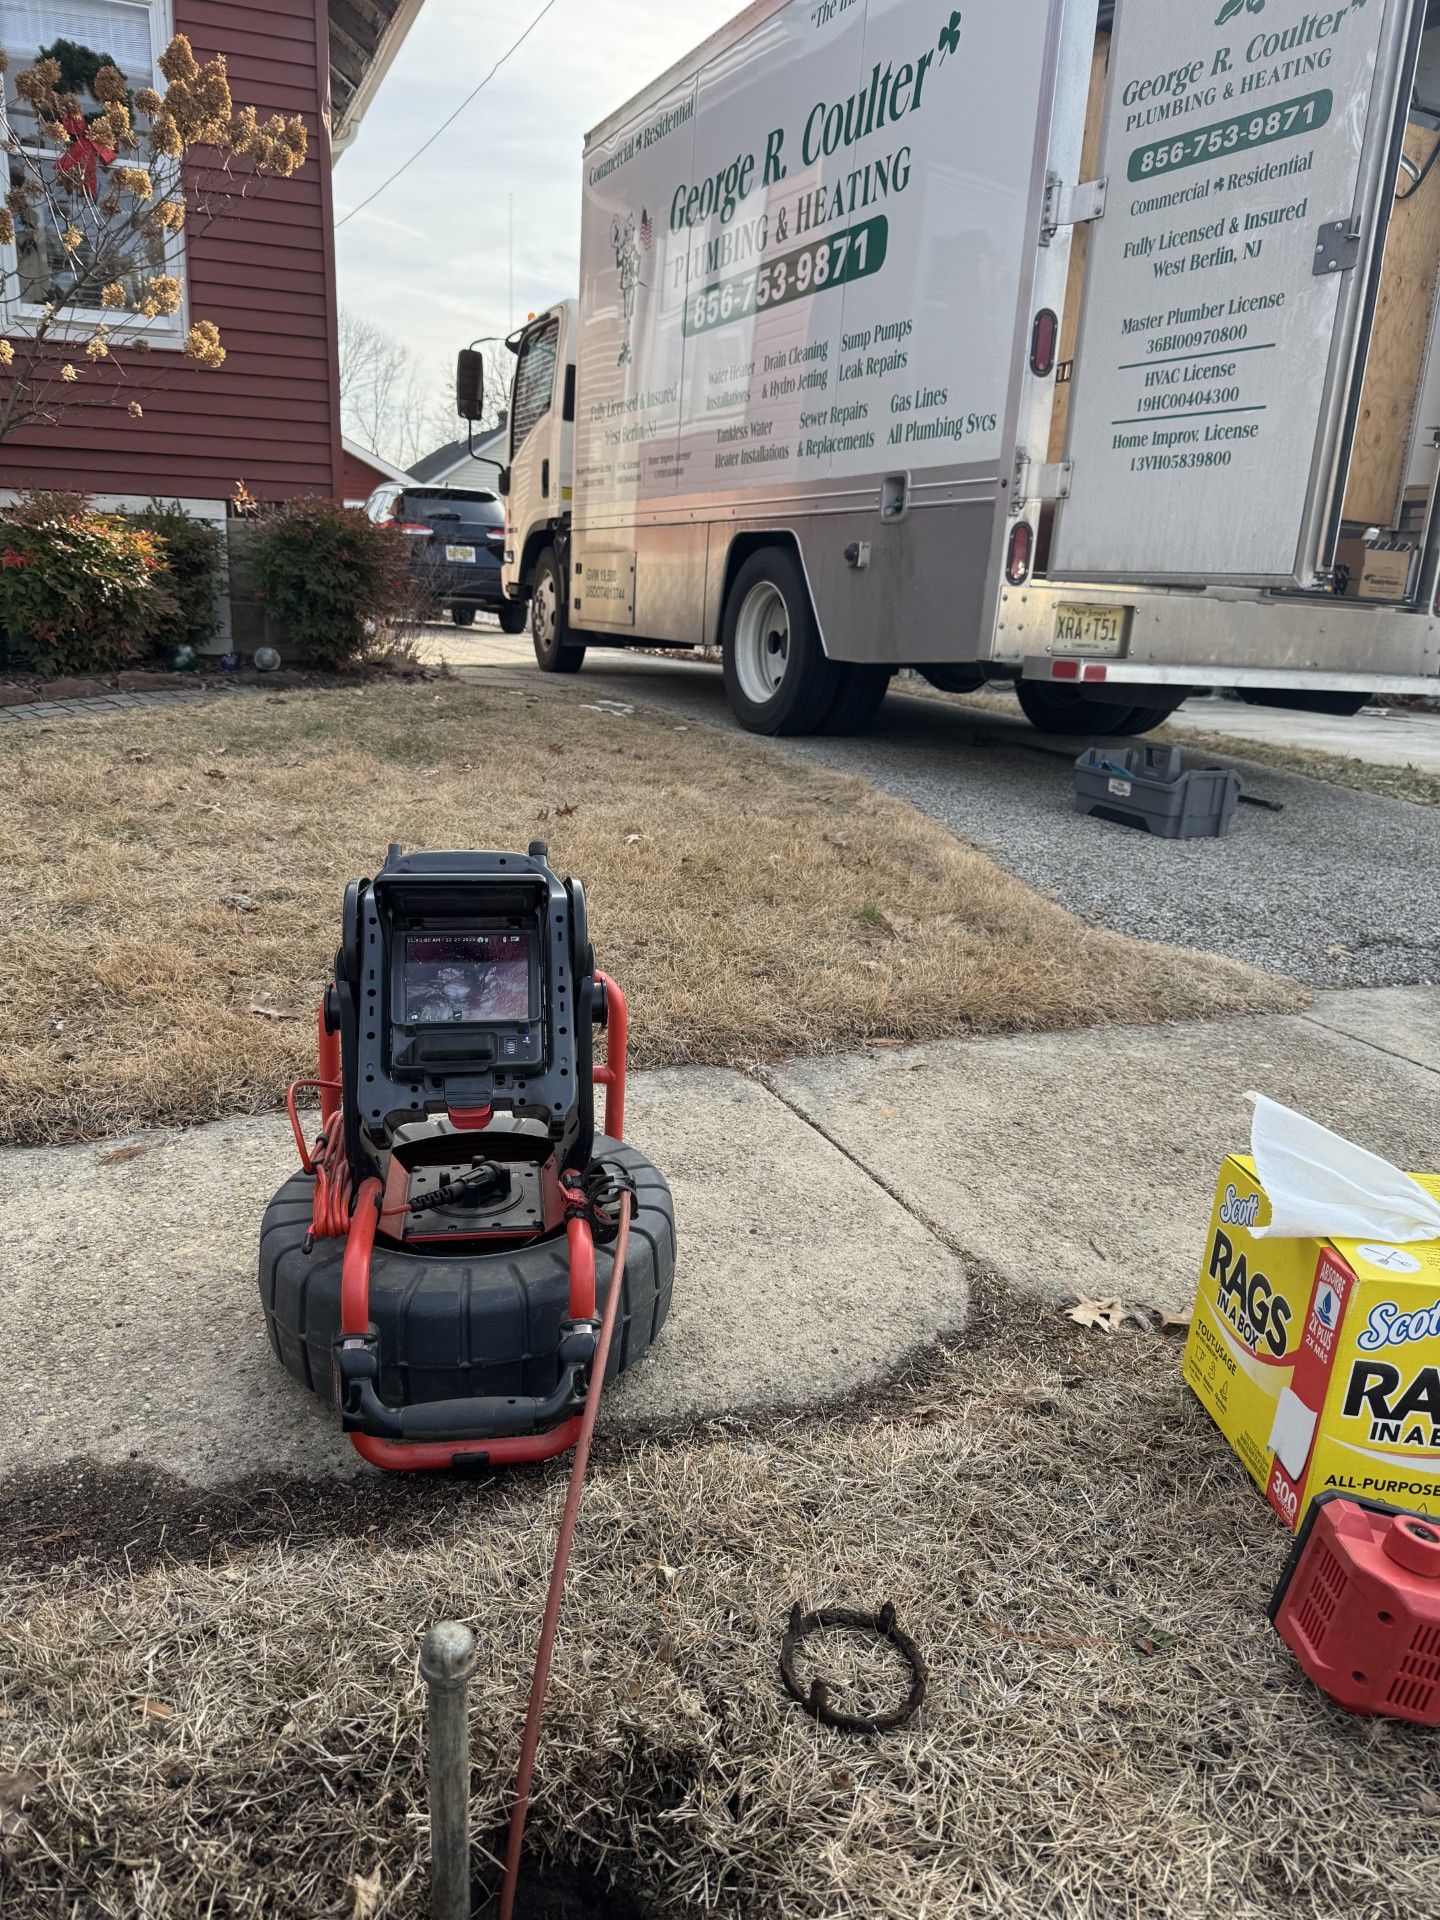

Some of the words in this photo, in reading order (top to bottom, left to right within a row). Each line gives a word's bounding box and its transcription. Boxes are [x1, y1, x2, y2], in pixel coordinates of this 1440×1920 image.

[1122, 59, 1204, 107] George
[1210, 47, 1233, 77] R.
[1246, 7, 1348, 63] Coulter
[1126, 87, 1217, 132] PLUMBING
[1222, 82, 1234, 100] &
[1240, 47, 1332, 95] HEATING
[589, 136, 634, 186] Commercial
[643, 96, 694, 149] Residential
[670, 153, 755, 236] George
[762, 128, 787, 189] R.
[802, 48, 936, 167] Coulter
[1141, 101, 1315, 172] 856-753-9871
[1130, 179, 1210, 216] Commercial
[1227, 150, 1314, 191] Residential
[673, 214, 769, 289] PLUMBING
[776, 206, 788, 244] &
[795, 146, 912, 236] HEATING
[1123, 236, 1157, 259] Fully
[1159, 217, 1225, 251] Licensed
[1229, 216, 1239, 235] &
[1244, 197, 1308, 231] Insured
[1153, 258, 1186, 279] West
[1189, 247, 1237, 271] Berlin,
[1242, 239, 1263, 260] NJ
[693, 228, 869, 329] 856-753-9871
[1121, 313, 1164, 335] Master
[1166, 302, 1225, 326] Plumber
[1228, 292, 1285, 315] License
[841, 330, 871, 352] Sump
[874, 318, 913, 344] Pumps
[1146, 324, 1248, 354] 36BI00970800
[763, 350, 787, 372] Drain
[788, 340, 828, 366] Cleaning
[839, 358, 863, 382] Leak
[866, 349, 908, 377] Repairs
[762, 383, 768, 399] &
[769, 377, 796, 400] Hydro
[797, 369, 828, 391] Jetting
[1144, 368, 1180, 387] HVAC
[1182, 363, 1236, 382] License
[799, 411, 828, 430] Sewer
[830, 400, 868, 426] Repairs
[891, 394, 911, 414] Gas
[915, 387, 948, 410] Lines
[1136, 386, 1240, 412] 19HC00404300
[717, 424, 748, 444] Tankless
[750, 421, 773, 437] Water
[797, 441, 804, 457] &
[806, 429, 875, 459] Replacements
[887, 422, 903, 445] All
[905, 415, 963, 442] Plumbing
[966, 412, 997, 434] Svcs
[1112, 434, 1148, 449] Home
[1152, 429, 1199, 448] Improv.
[1204, 423, 1259, 442] License
[715, 452, 740, 469] Heater
[741, 444, 789, 466] Installations
[1130, 450, 1231, 472] 13VH05839800
[1056, 616, 1082, 640] XRA
[1093, 618, 1118, 641] T51
[1220, 1184, 1259, 1227] Scott
[1208, 1228, 1292, 1358] RAGS
[1216, 1289, 1230, 1313] IN
[1228, 1309, 1237, 1327] A
[1237, 1317, 1258, 1353] BOX
[1308, 1312, 1319, 1335] 2X
[1317, 1323, 1335, 1351] PLUS
[1197, 1319, 1237, 1376] TOUT-USAGE
[1305, 1335, 1315, 1350] 2X
[1370, 1421, 1401, 1443] IN
[1404, 1426, 1425, 1446] A
[1272, 1470, 1298, 1515] 300
[1324, 1474, 1440, 1497] ALL-PURPOSE
